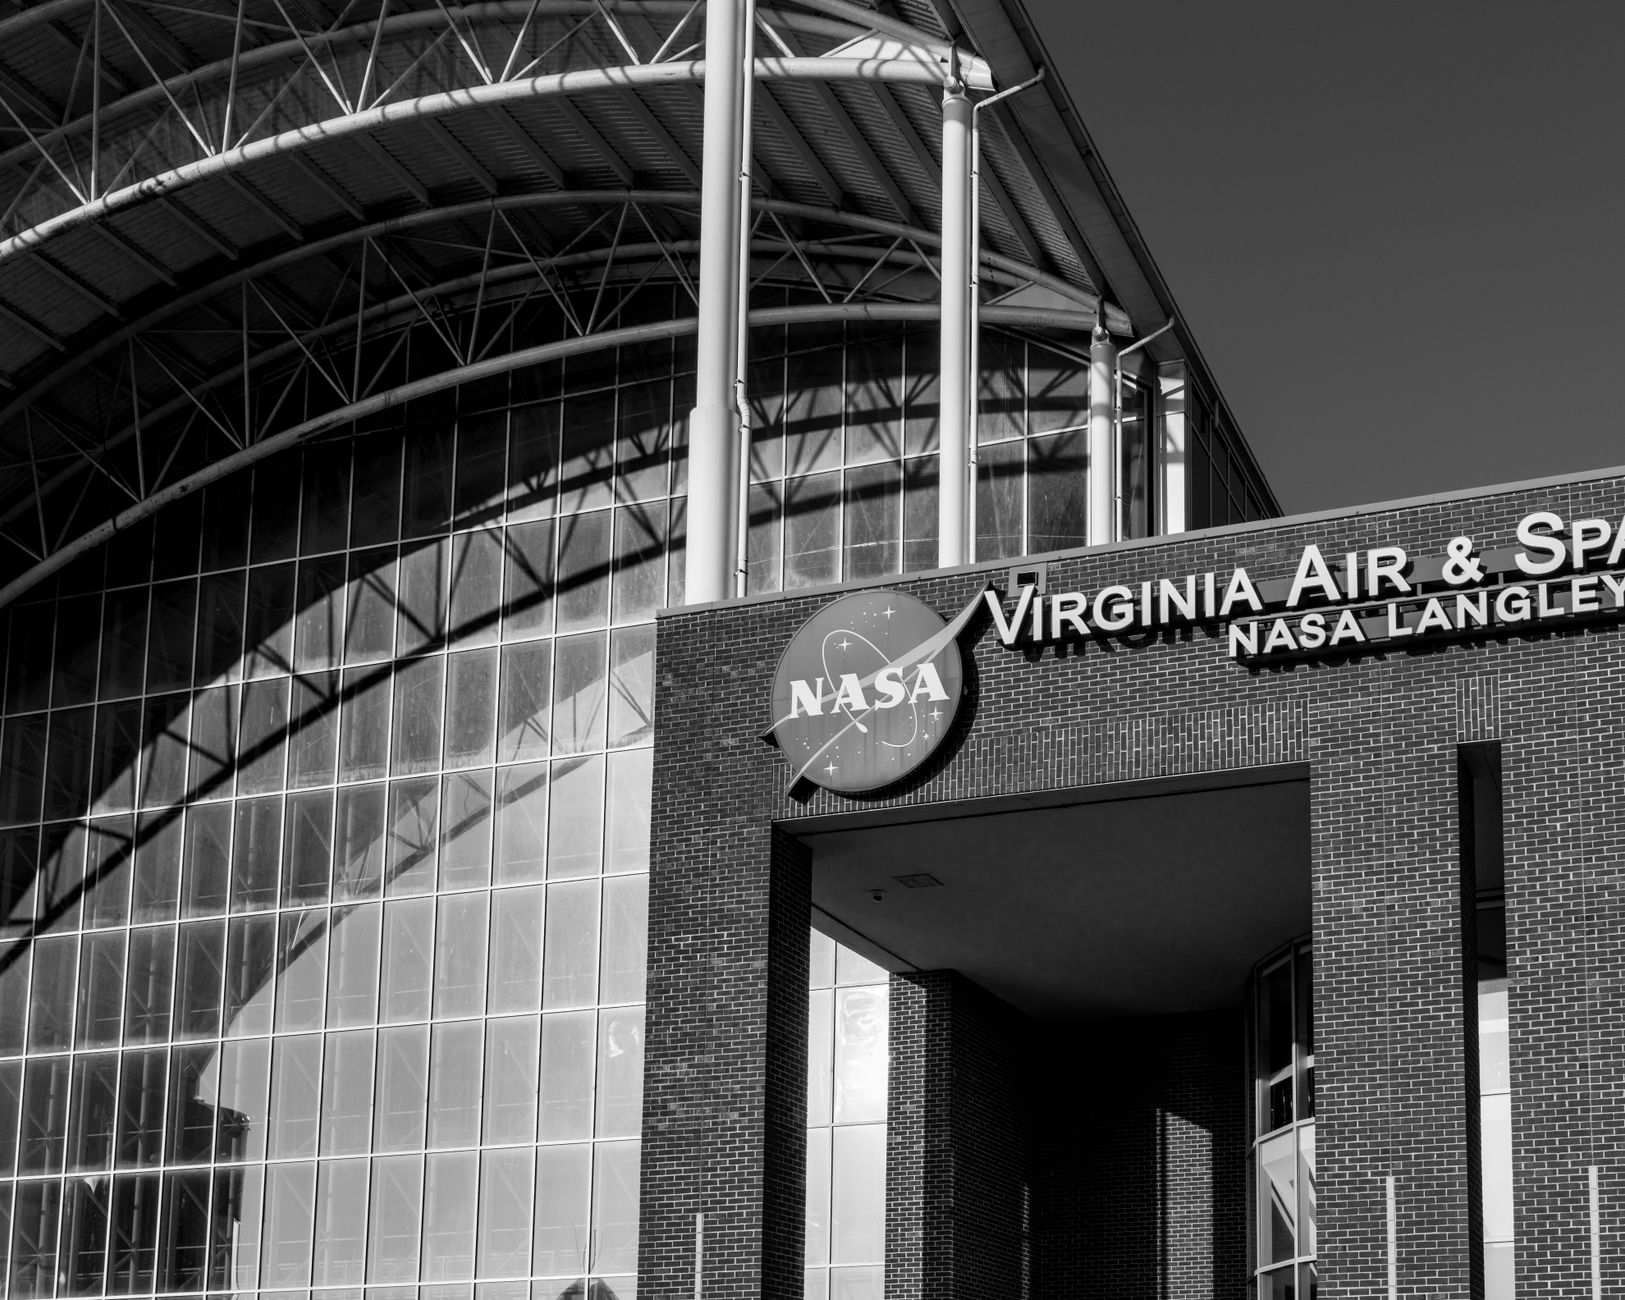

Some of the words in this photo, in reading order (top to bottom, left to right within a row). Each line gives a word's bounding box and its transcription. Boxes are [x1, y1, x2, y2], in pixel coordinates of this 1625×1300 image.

[984, 567, 1263, 645] VIRGINIA
[1285, 544, 1412, 607] AIR
[1441, 536, 1485, 585] &
[1228, 609, 1366, 657] NASA
[1387, 574, 1625, 638] LANGLEY
[788, 662, 950, 719] NASA
